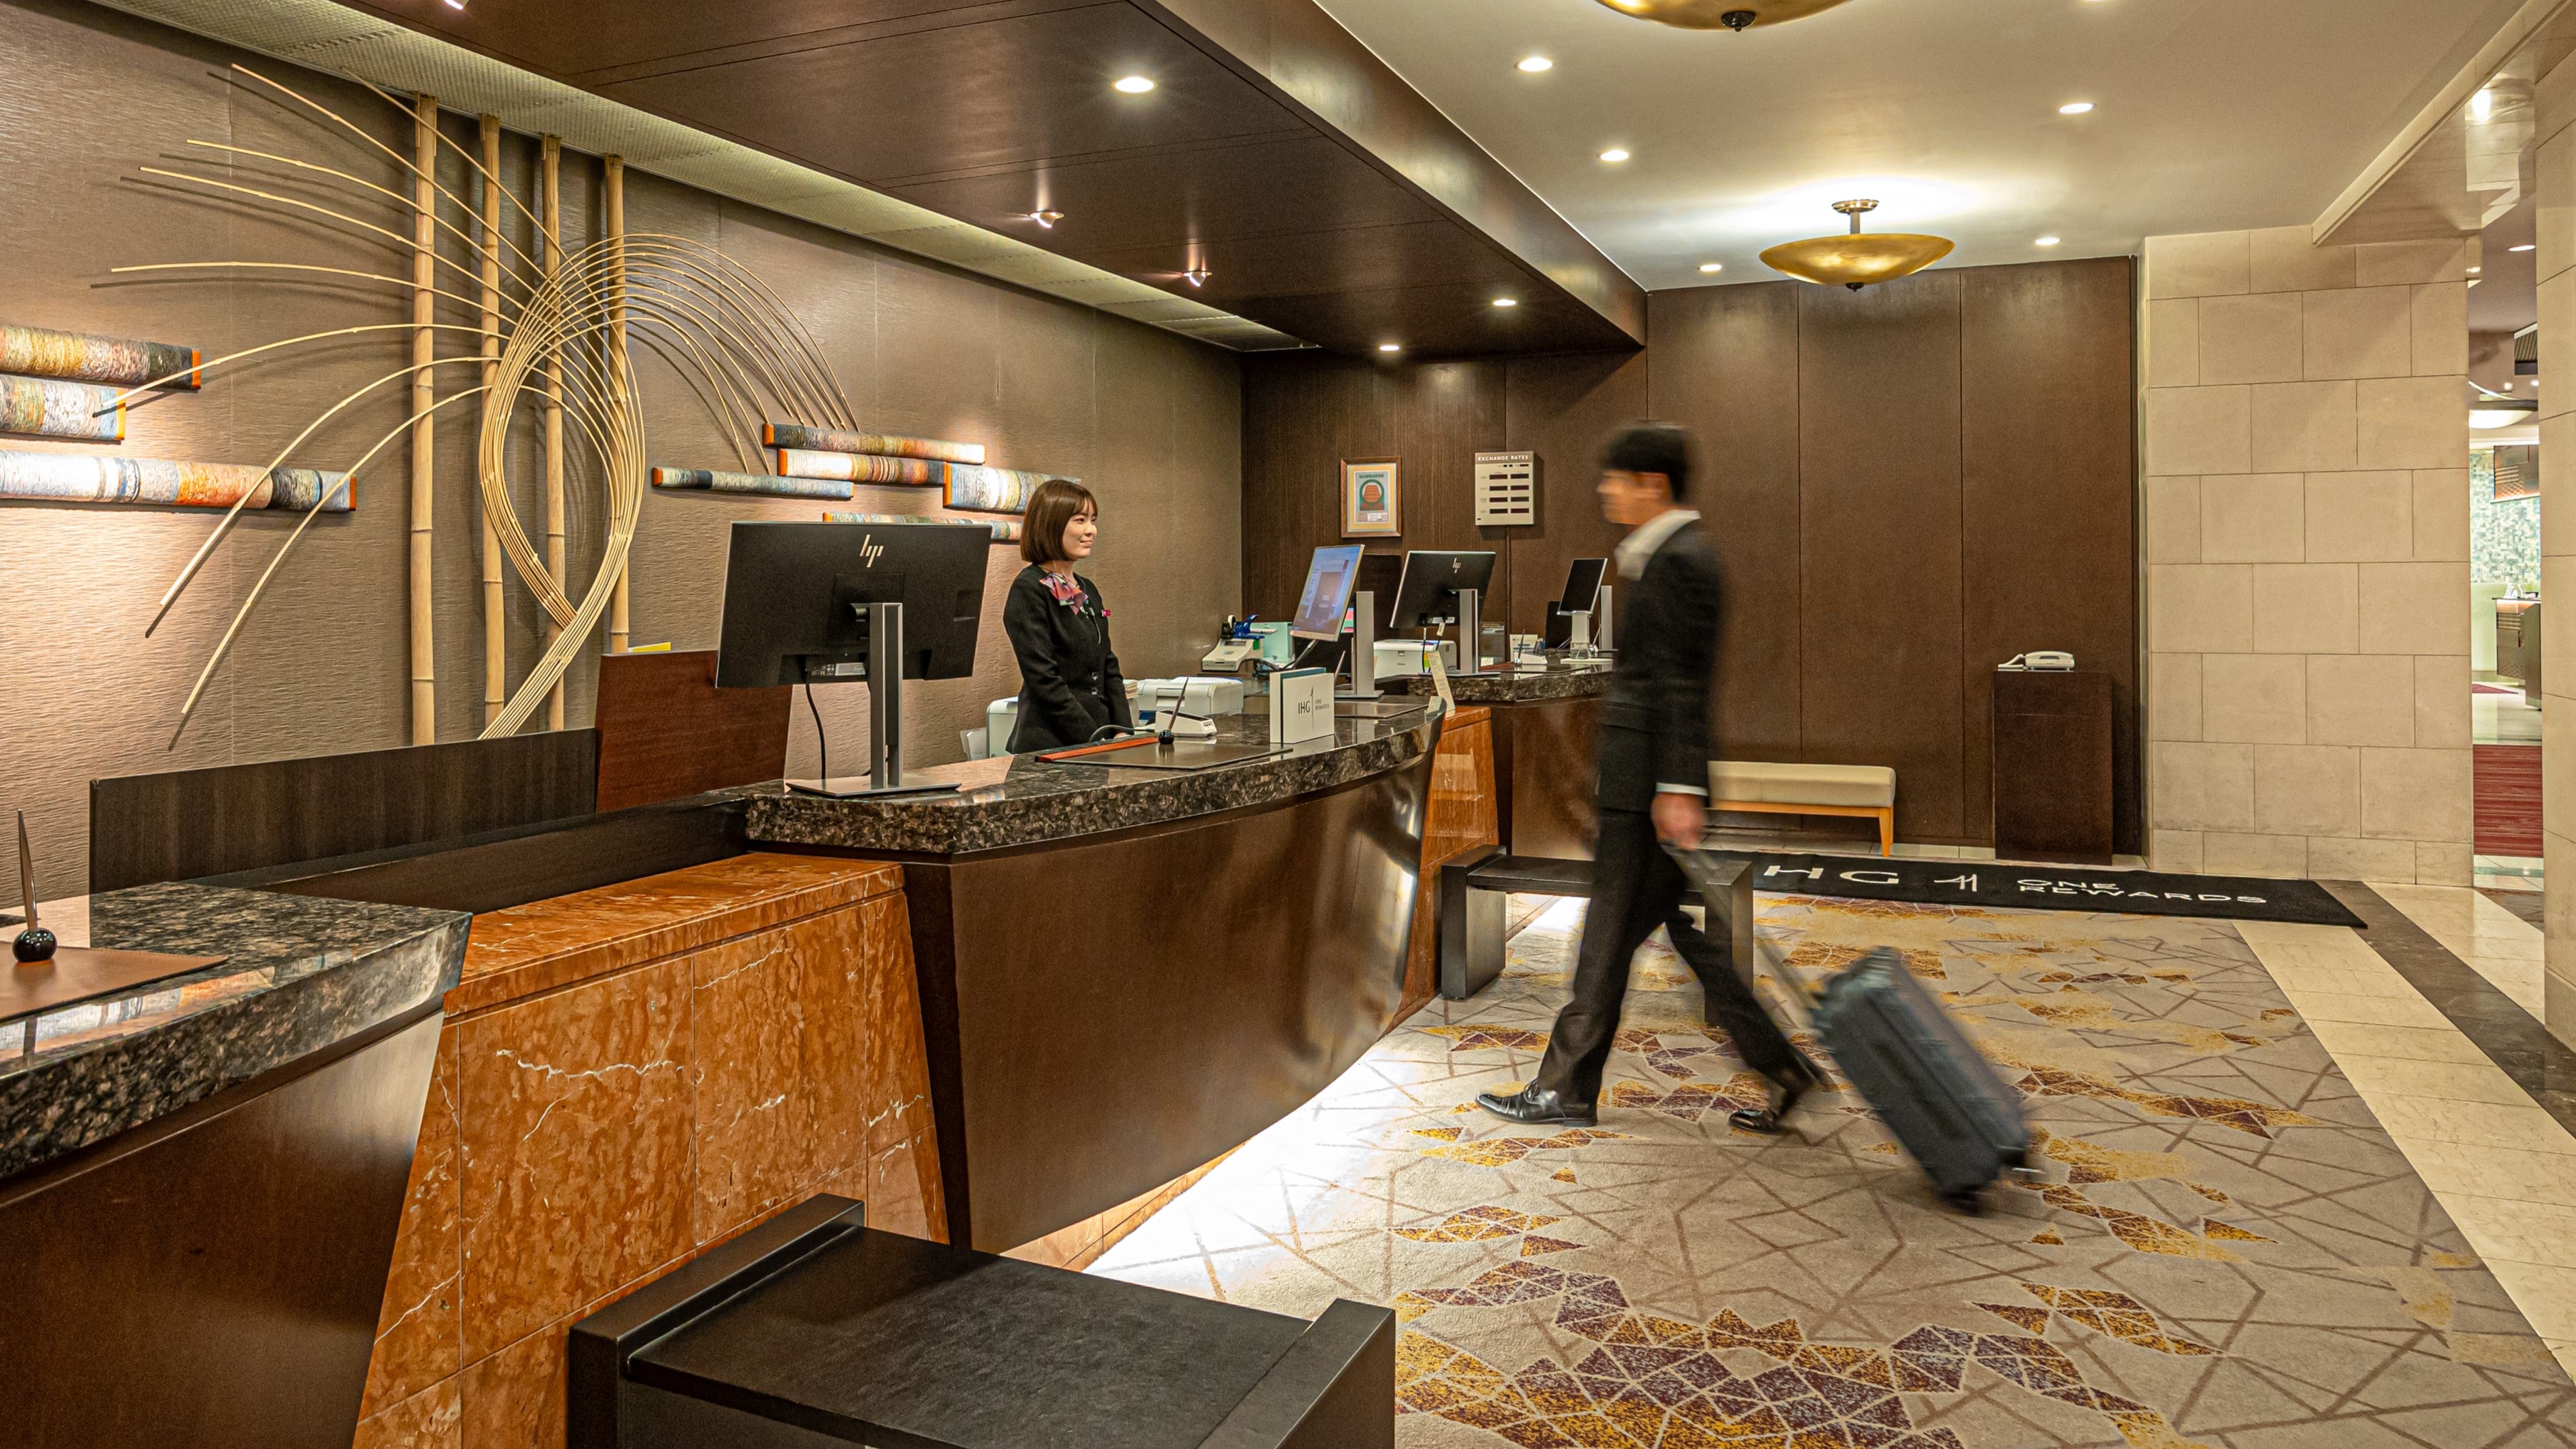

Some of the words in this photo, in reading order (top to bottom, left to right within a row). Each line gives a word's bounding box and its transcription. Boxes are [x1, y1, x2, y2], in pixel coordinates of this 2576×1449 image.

[860, 534, 884, 568] hp
[1452, 557, 1462, 574] hp
[1298, 701, 1310, 714] IHG
[1763, 864, 1900, 885] HG
[2017, 879, 2119, 890] ONE
[2020, 885, 2267, 903] REWARDS
